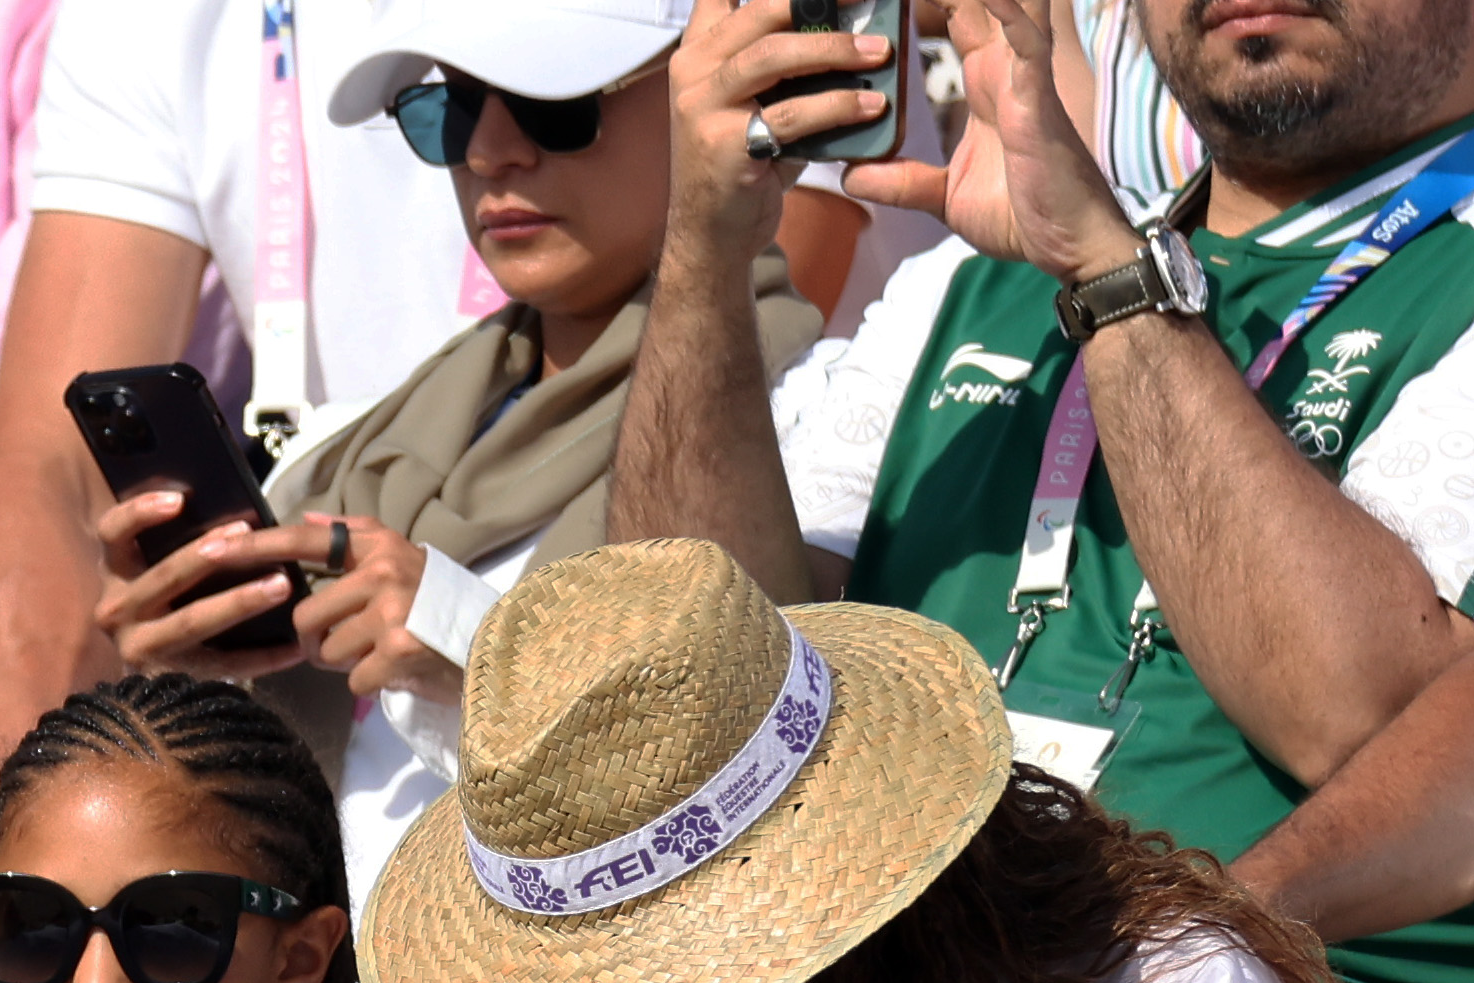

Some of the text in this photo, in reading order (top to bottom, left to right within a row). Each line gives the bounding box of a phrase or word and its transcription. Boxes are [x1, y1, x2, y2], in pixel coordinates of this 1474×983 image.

[268, 96, 293, 290] PARIS 2024
[1371, 198, 1420, 244] Atos
[1286, 396, 1352, 423] Saudi
[1049, 406, 1090, 485] PARIS
[715, 760, 761, 807] FÉDÉRATION
[727, 759, 787, 823] INTERNATIONALE
[573, 848, 657, 899] FEI
